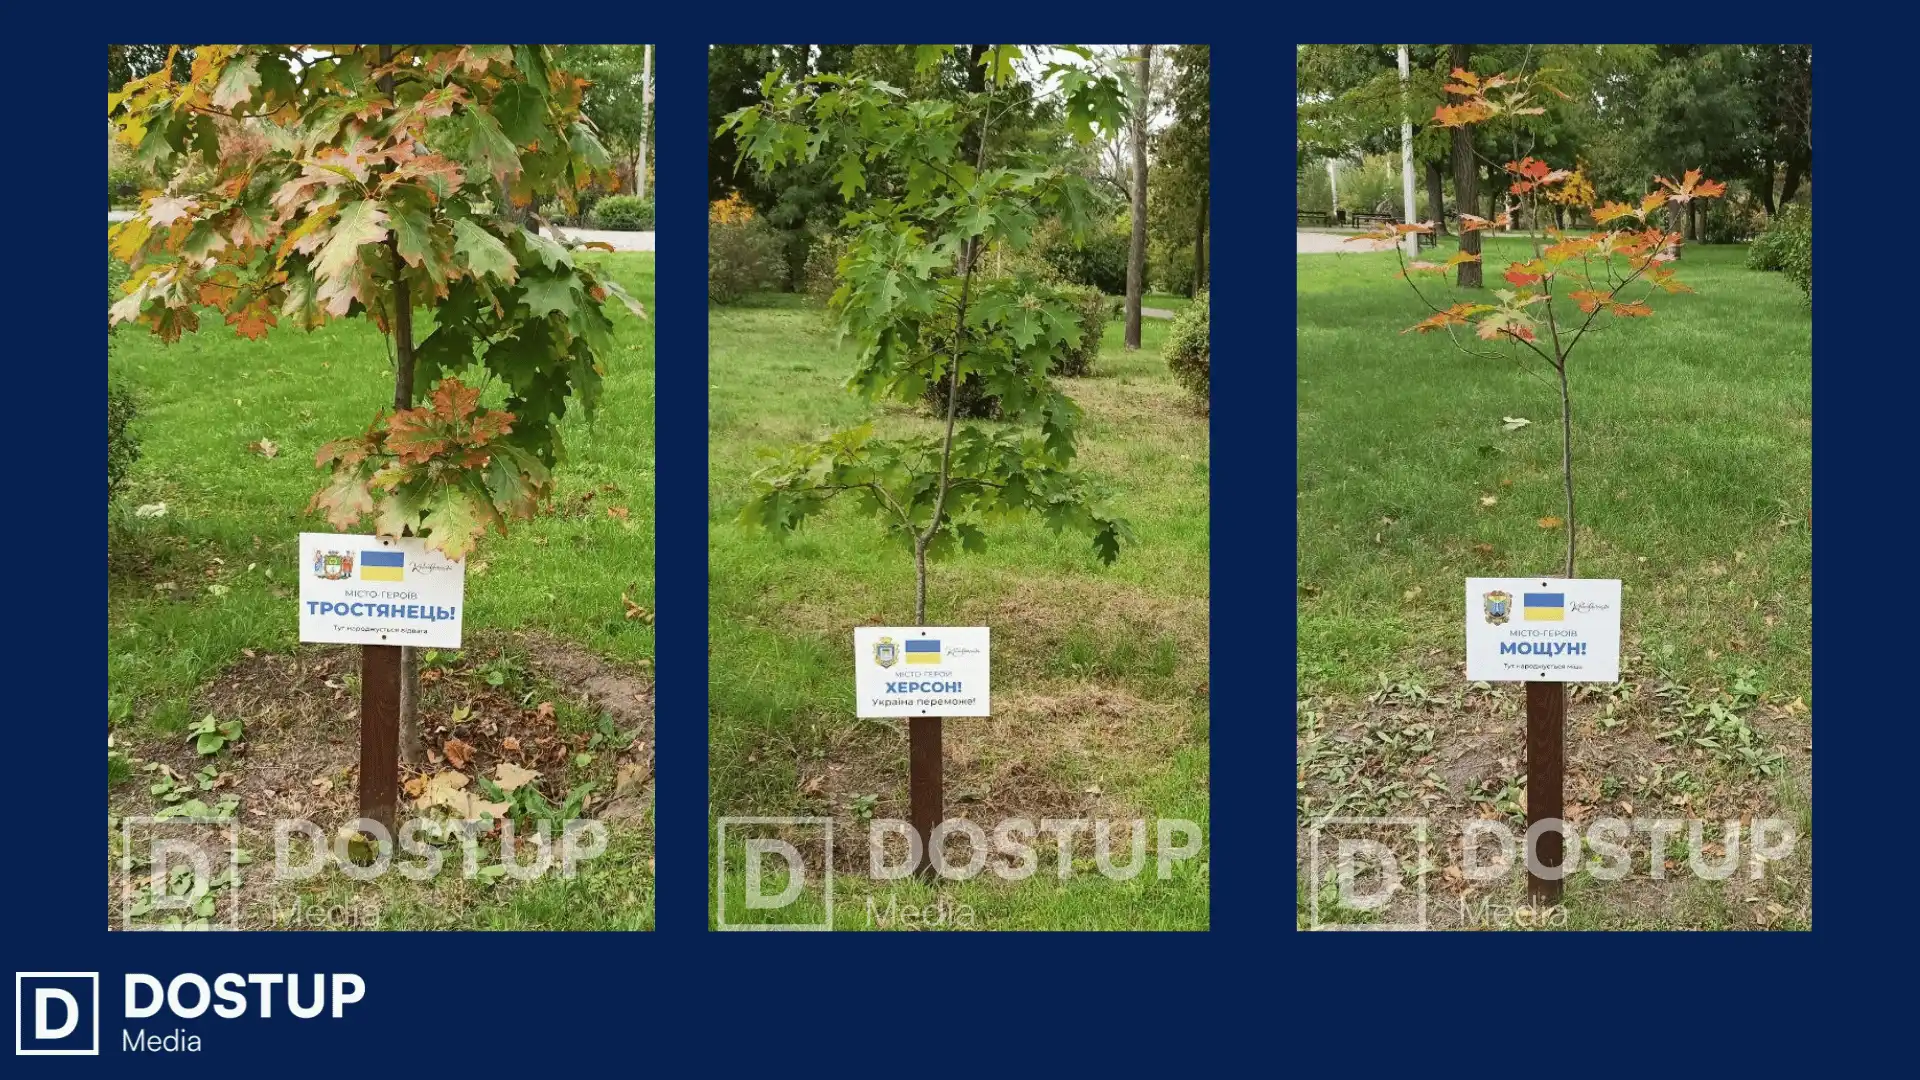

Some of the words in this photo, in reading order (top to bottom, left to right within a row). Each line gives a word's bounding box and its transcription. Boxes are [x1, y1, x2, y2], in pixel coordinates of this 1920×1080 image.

[306, 600, 456, 622] ТРОСТЯНЕЦЬ!
[1499, 641, 1587, 658] МОЩУН!
[885, 681, 962, 694] ХЕРСОН!
[872, 697, 914, 707] Україна
[916, 698, 976, 707] переможе!
